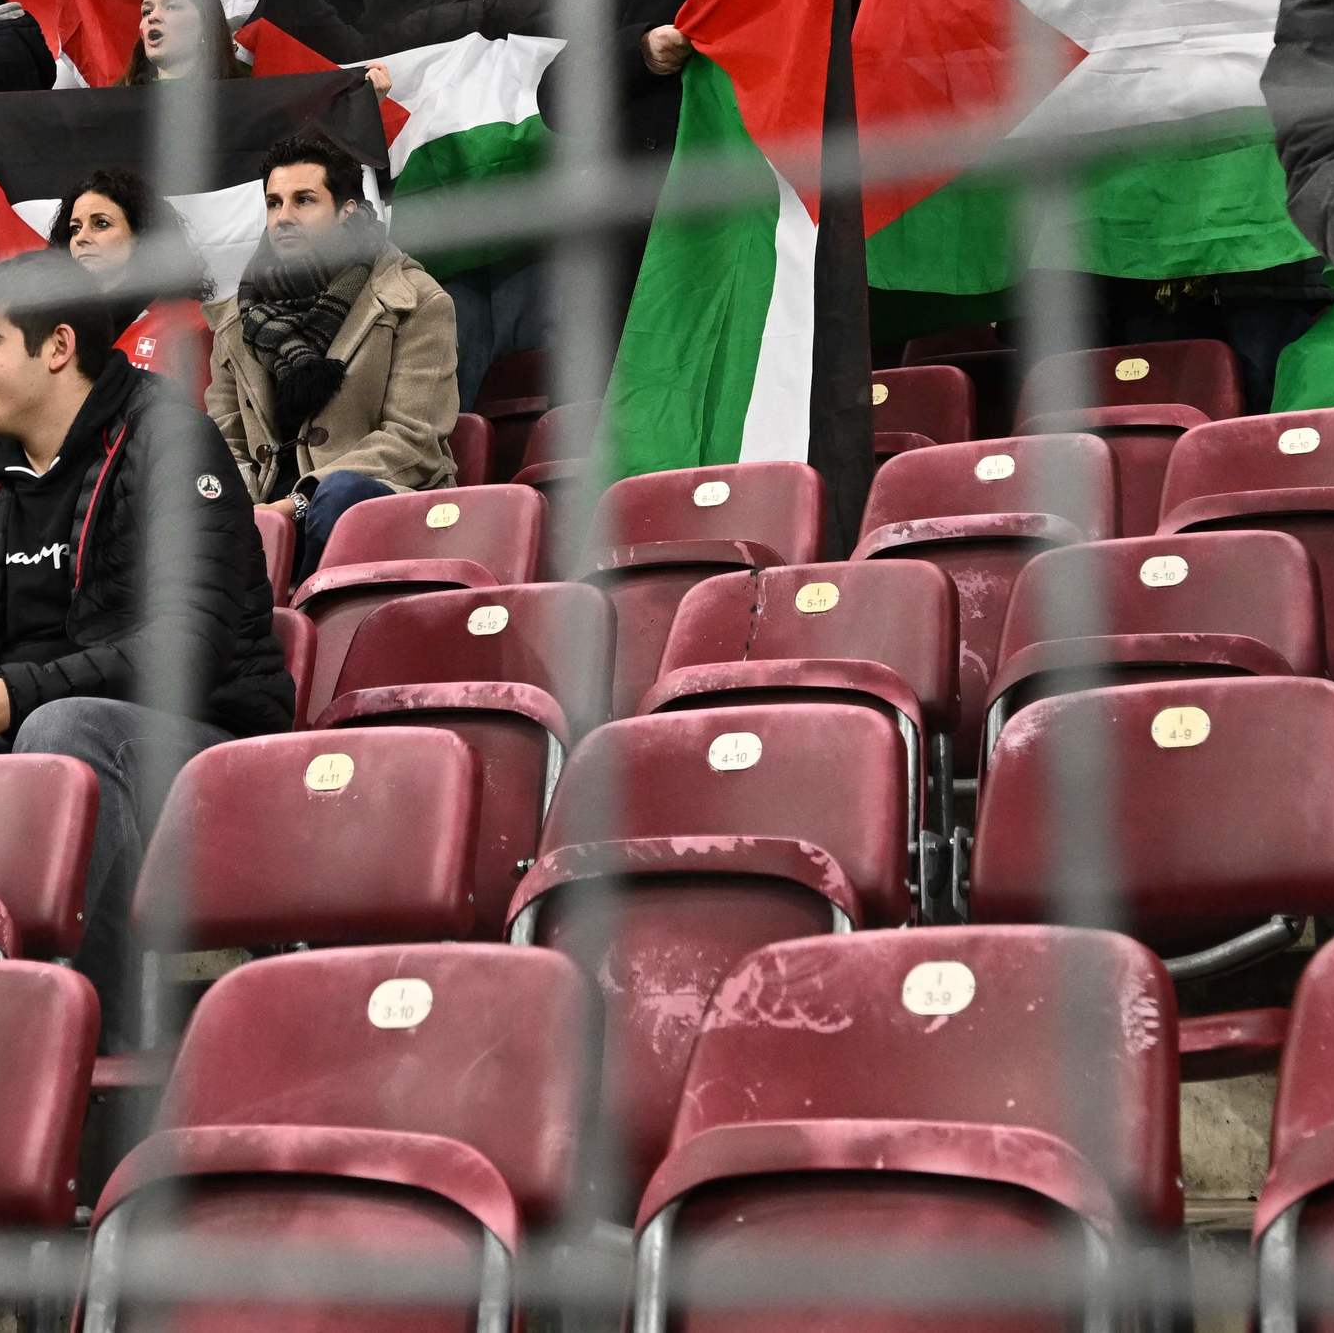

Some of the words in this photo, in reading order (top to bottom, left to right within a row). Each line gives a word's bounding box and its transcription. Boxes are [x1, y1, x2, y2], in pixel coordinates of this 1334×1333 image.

[1152, 573, 1175, 582] 5-10
[807, 599, 827, 608] 5-11
[477, 621, 498, 630] 5-12
[1169, 729, 1192, 740] 4-9
[721, 752, 747, 763] 4-10
[318, 774, 340, 784] 4-11
[924, 992, 952, 1006] 3-9
[384, 1006, 415, 1020] 3-10
